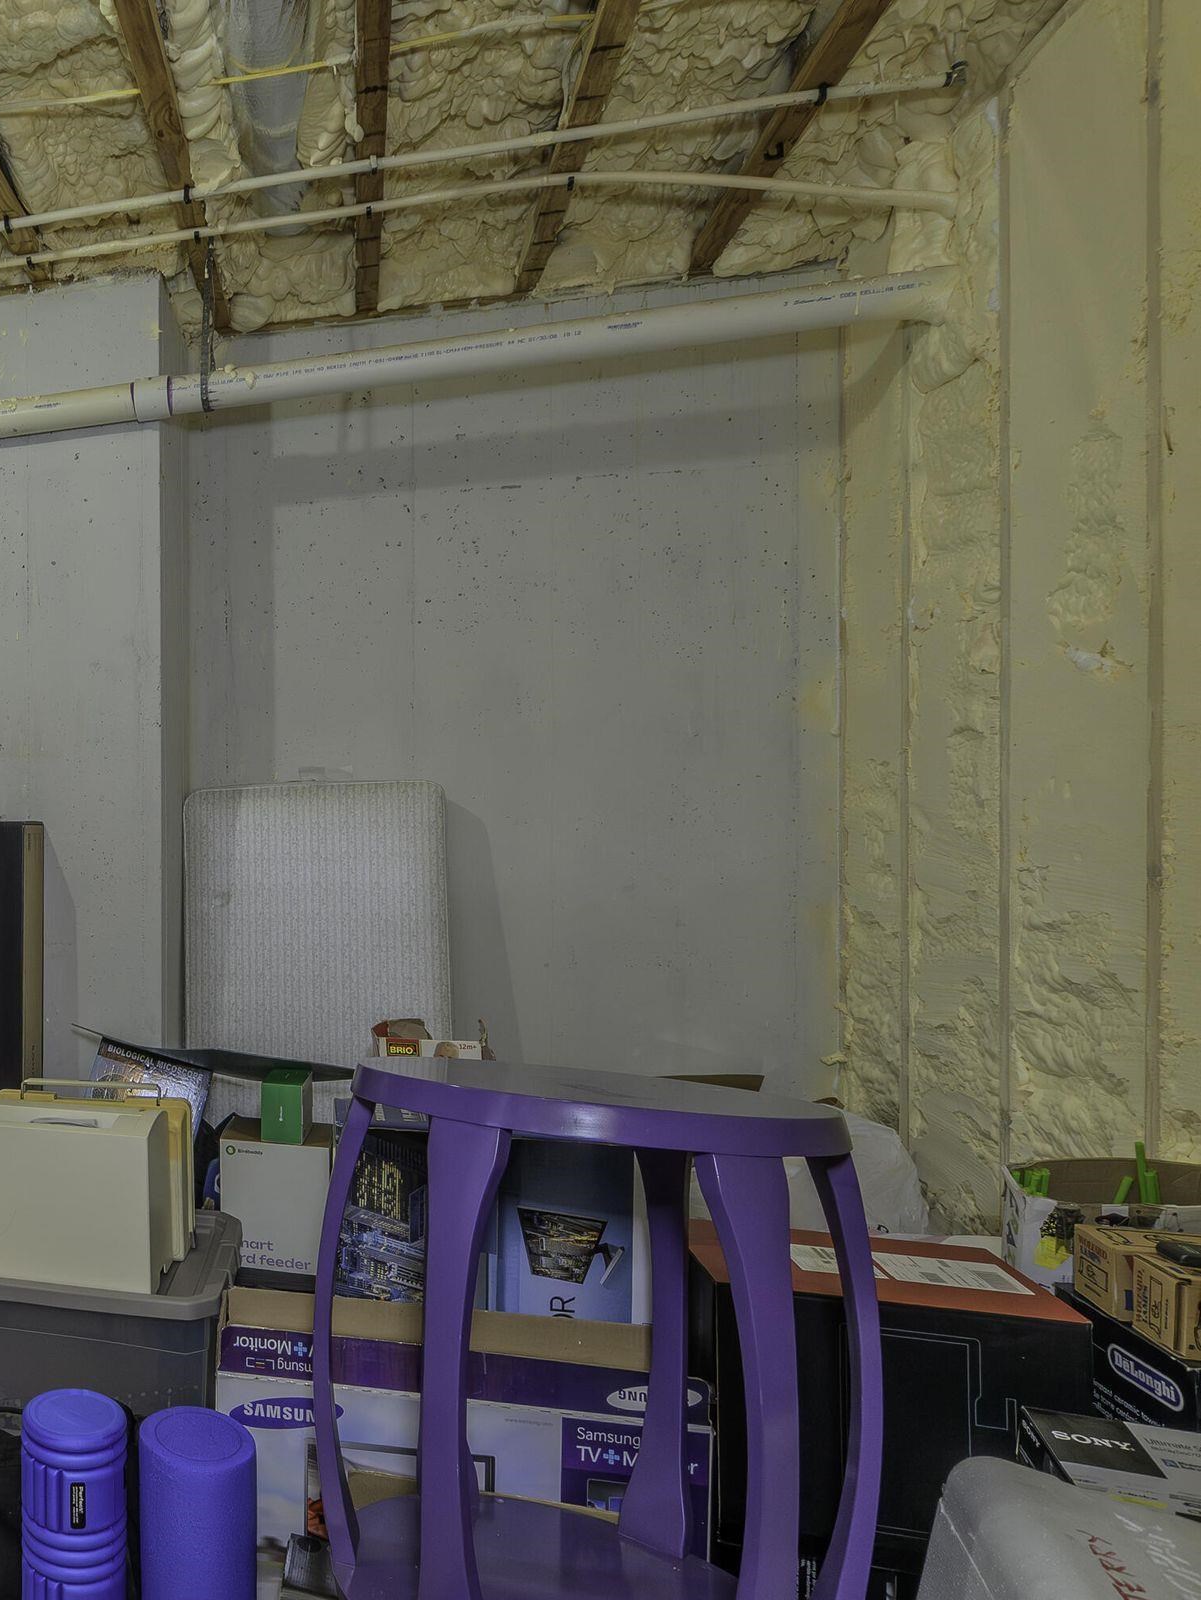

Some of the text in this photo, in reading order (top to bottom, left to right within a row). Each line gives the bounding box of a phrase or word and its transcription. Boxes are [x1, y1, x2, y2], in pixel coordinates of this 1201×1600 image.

[107, 1044, 154, 1066] BIOLOGICAL
[390, 1046, 414, 1055] BRIO
[259, 1255, 311, 1271] feeder
[243, 1402, 315, 1423] SAMSUN
[576, 1427, 641, 1448] Samsung
[1022, 1419, 1040, 1447] SONY
[1051, 1430, 1134, 1451] SONY
